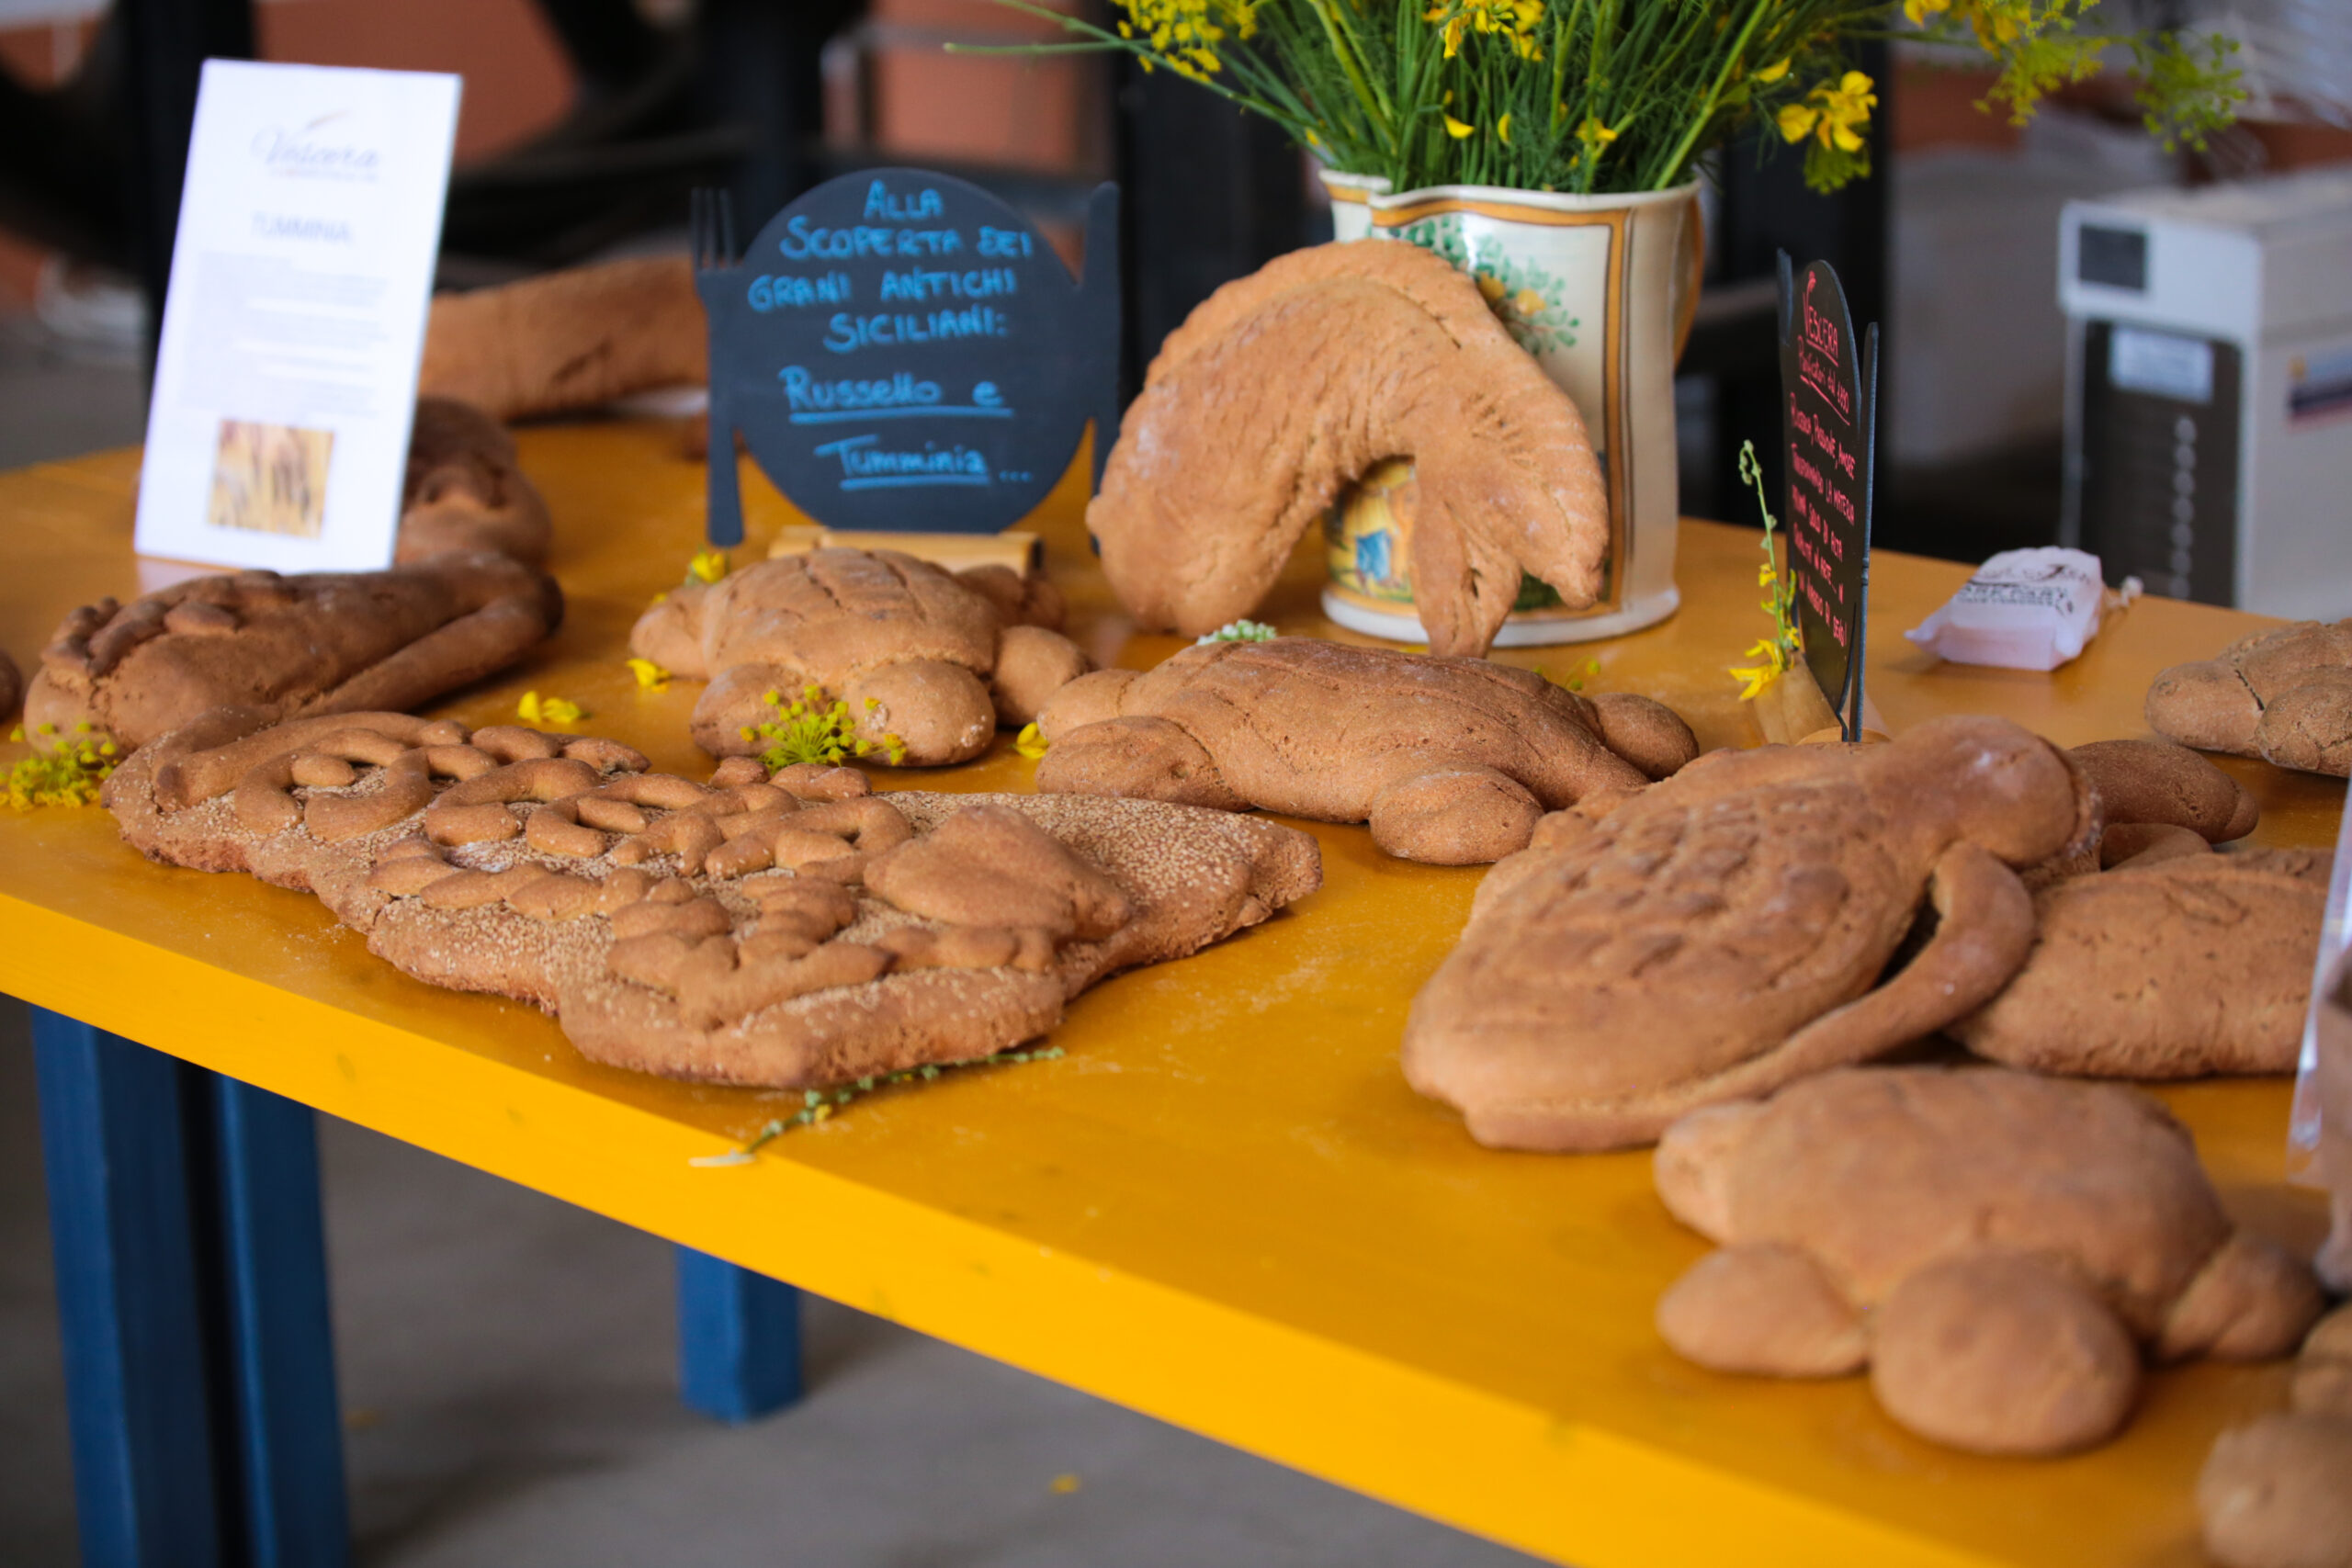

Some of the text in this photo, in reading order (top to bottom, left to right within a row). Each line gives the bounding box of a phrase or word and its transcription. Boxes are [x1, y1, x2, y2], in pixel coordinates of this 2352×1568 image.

[864, 178, 944, 220] ALLA
[779, 215, 964, 261] SCOPERTA
[747, 265, 1017, 313] GRANI ANTICHI
[822, 303, 1008, 354] SICILIANI:
[778, 365, 1004, 411] Russello e
